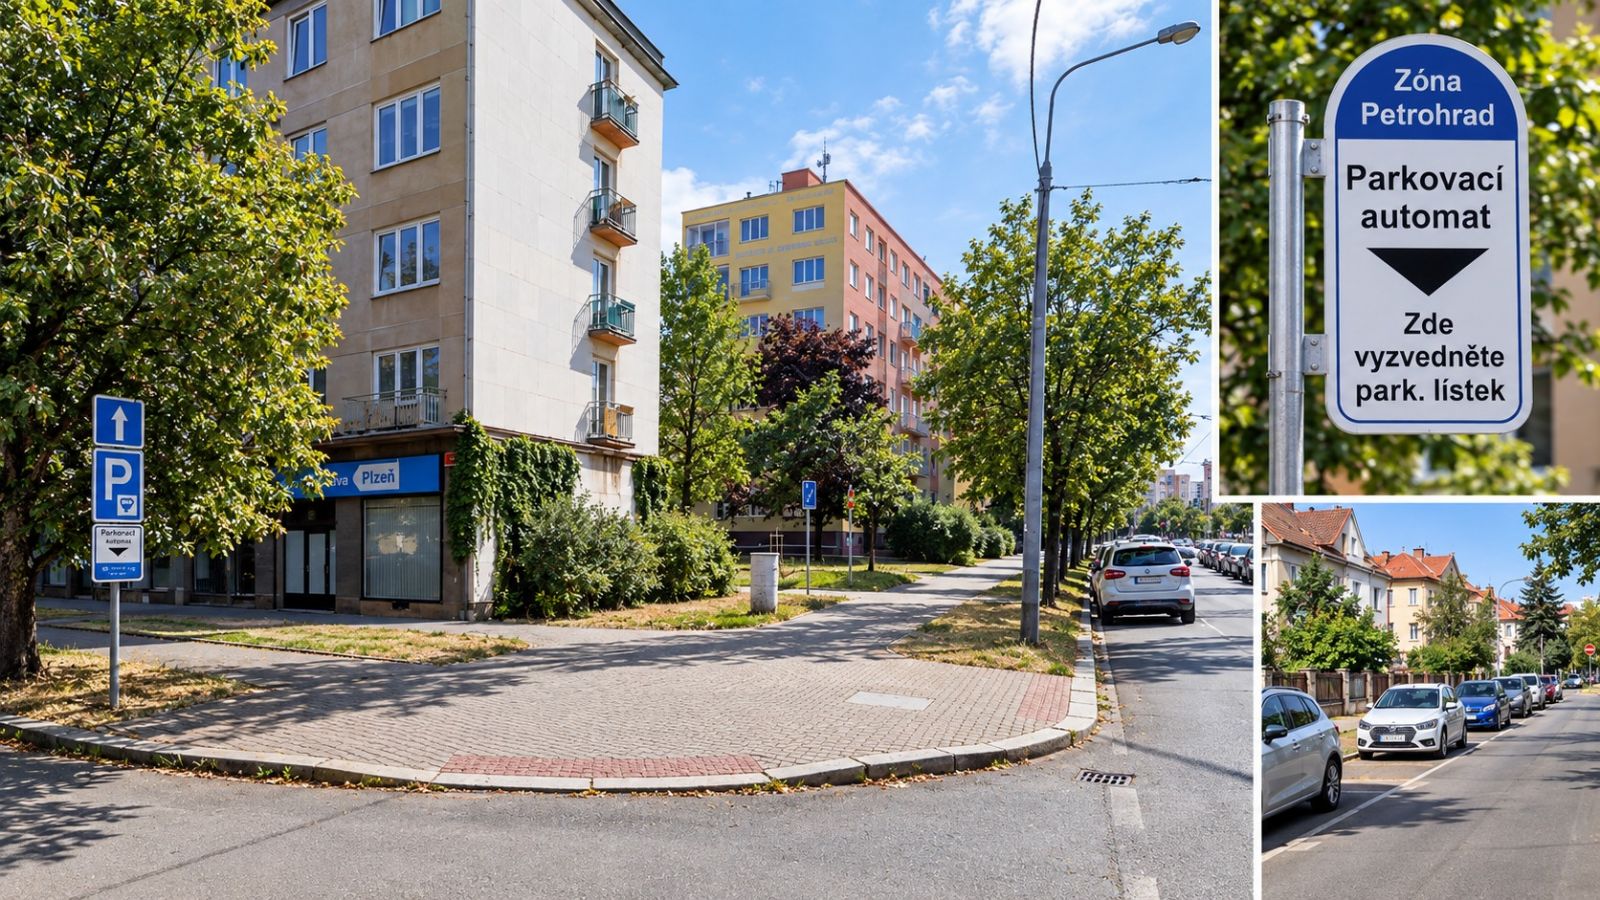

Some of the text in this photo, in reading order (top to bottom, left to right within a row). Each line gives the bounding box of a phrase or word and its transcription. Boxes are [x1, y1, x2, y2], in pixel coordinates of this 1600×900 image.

[1394, 68, 1462, 92] Zóna
[1361, 102, 1495, 126] Petrohrad
[1346, 164, 1504, 191] Parkovací
[1361, 204, 1491, 229] automat
[1403, 312, 1454, 335] Zde
[1354, 344, 1505, 372] vyzvedněte
[1356, 379, 1506, 407] park. lístek
[105, 458, 132, 500] P
[362, 468, 395, 485] Plzeň
